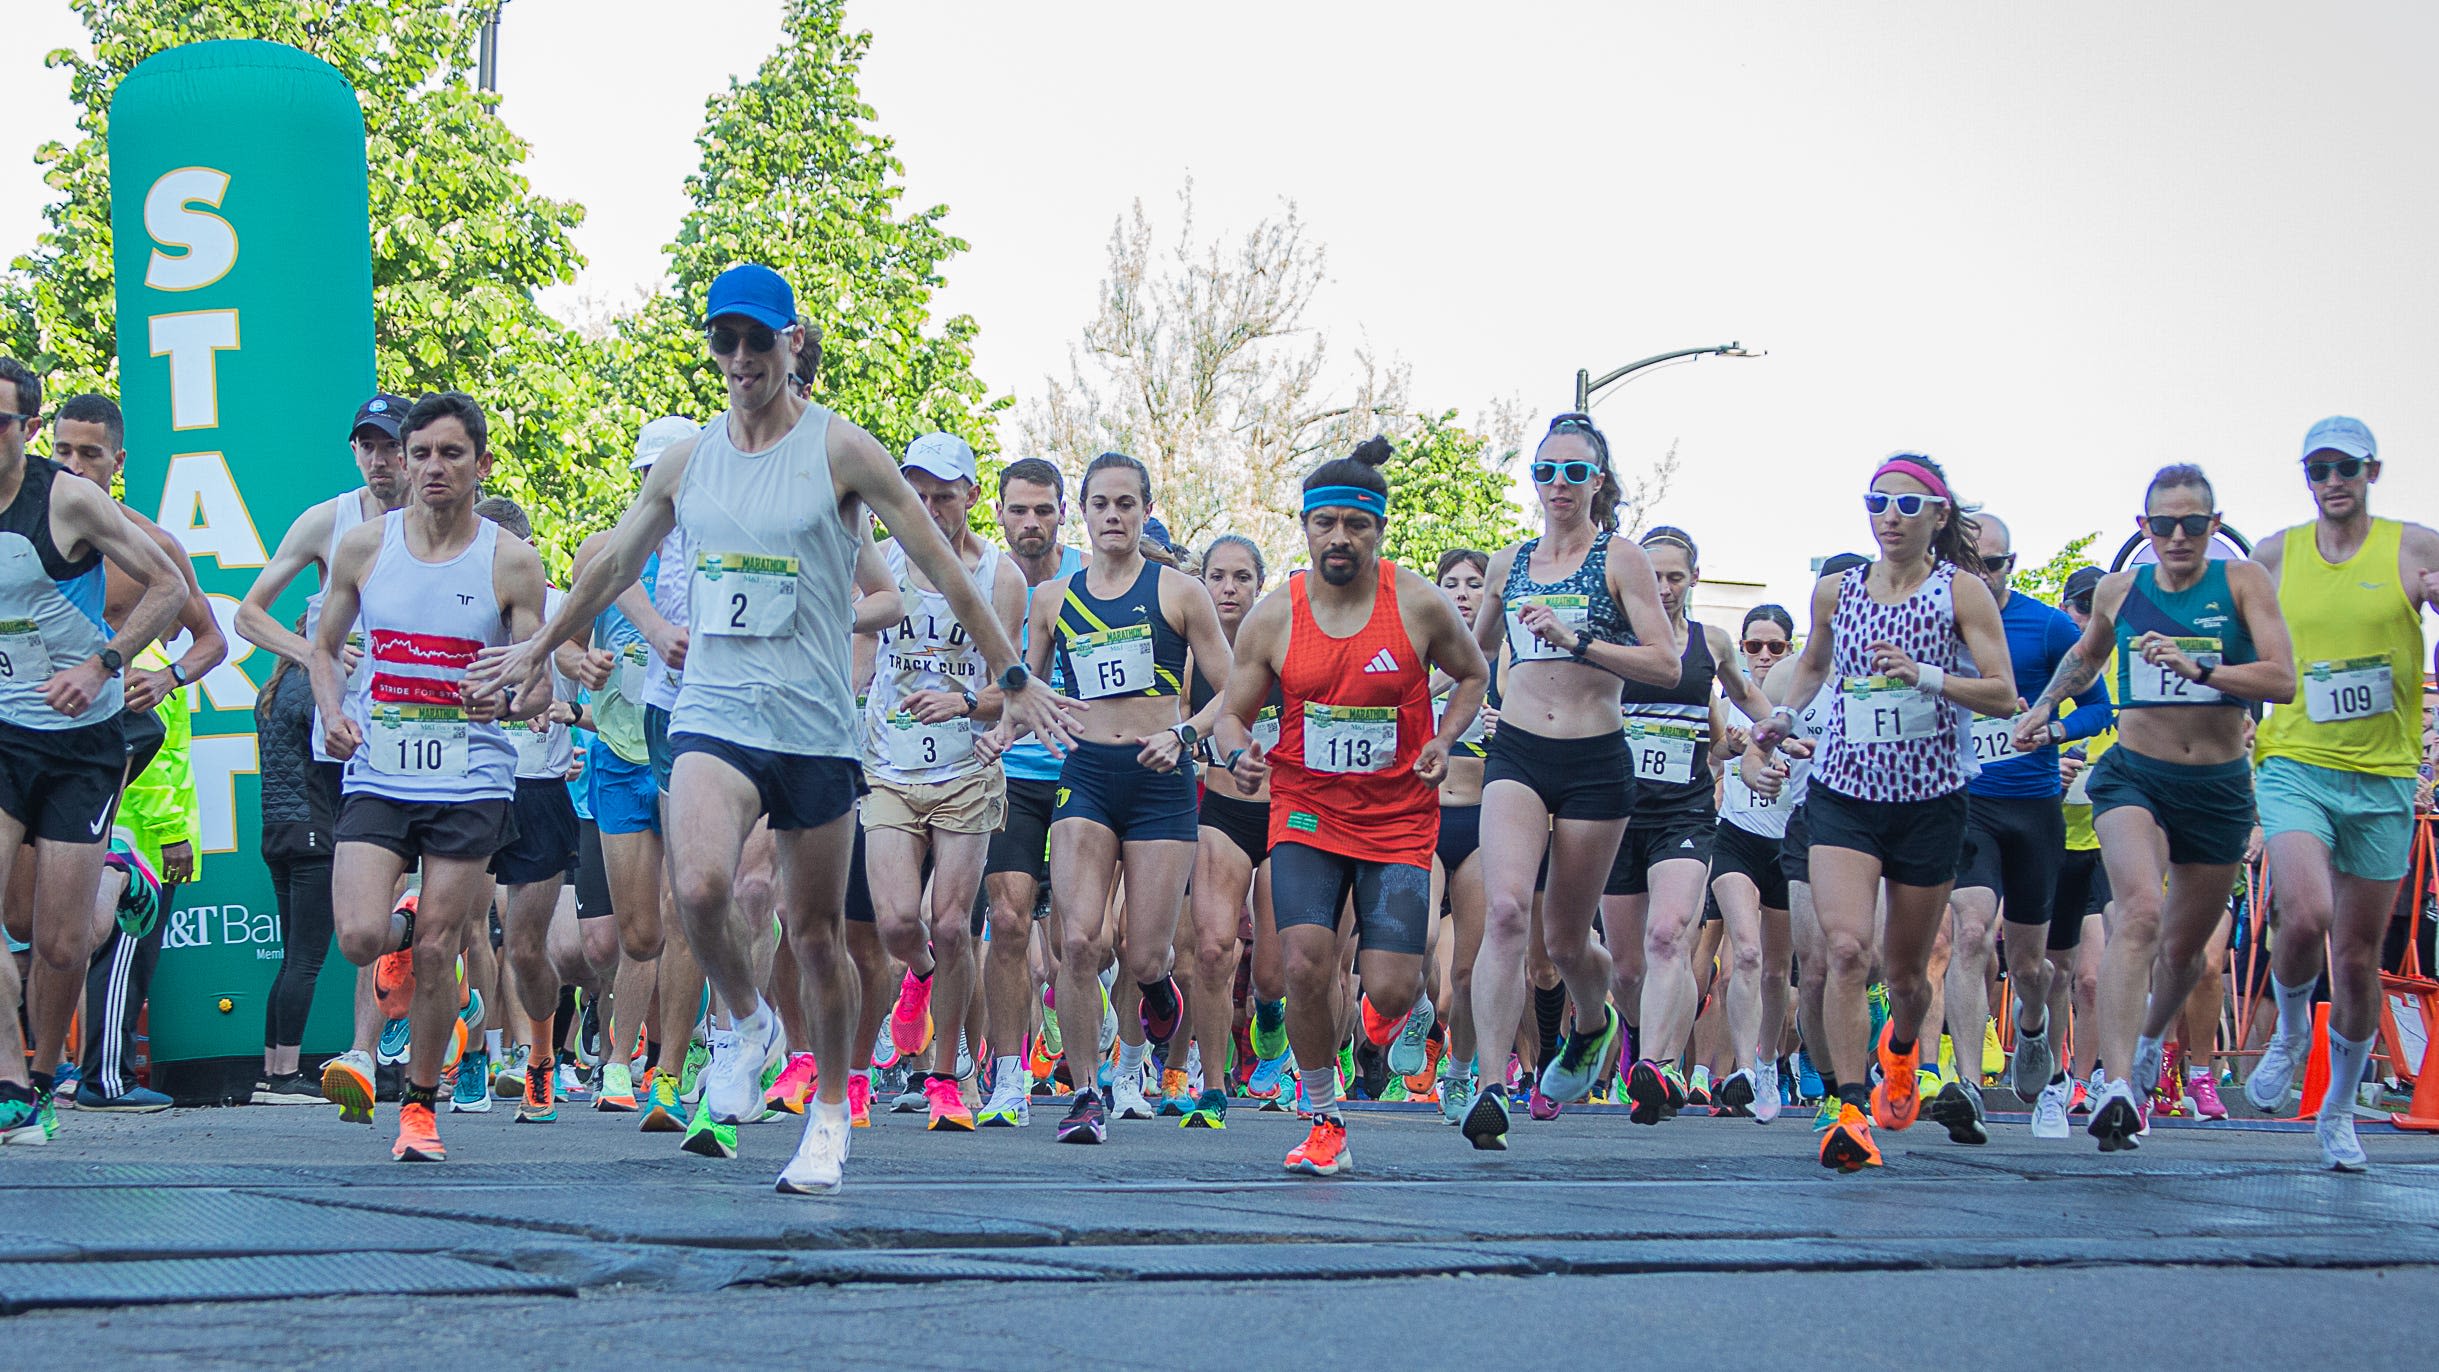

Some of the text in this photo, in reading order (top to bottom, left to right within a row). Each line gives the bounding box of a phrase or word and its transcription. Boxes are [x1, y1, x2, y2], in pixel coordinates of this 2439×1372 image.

[143, 165, 270, 854] START
[742, 556, 787, 572] MARATHON
[731, 592, 748, 628] 2
[1106, 627, 1143, 642] MARATHON
[889, 654, 976, 676] TRACK CLUB
[1098, 660, 1126, 690] F5
[379, 684, 409, 696] STRIDE
[415, 688, 436, 697] FOR
[2329, 685, 2372, 715] 109
[418, 707, 460, 720] MARATHON
[1349, 708, 1389, 721] MARATHON
[1874, 707, 1902, 737] F1
[1807, 726, 1823, 736] NO
[398, 739, 442, 770] 110
[922, 737, 937, 763] 3
[1328, 738, 1371, 767] 113
[1972, 732, 2012, 760] 212
[1641, 749, 1667, 775] F8
